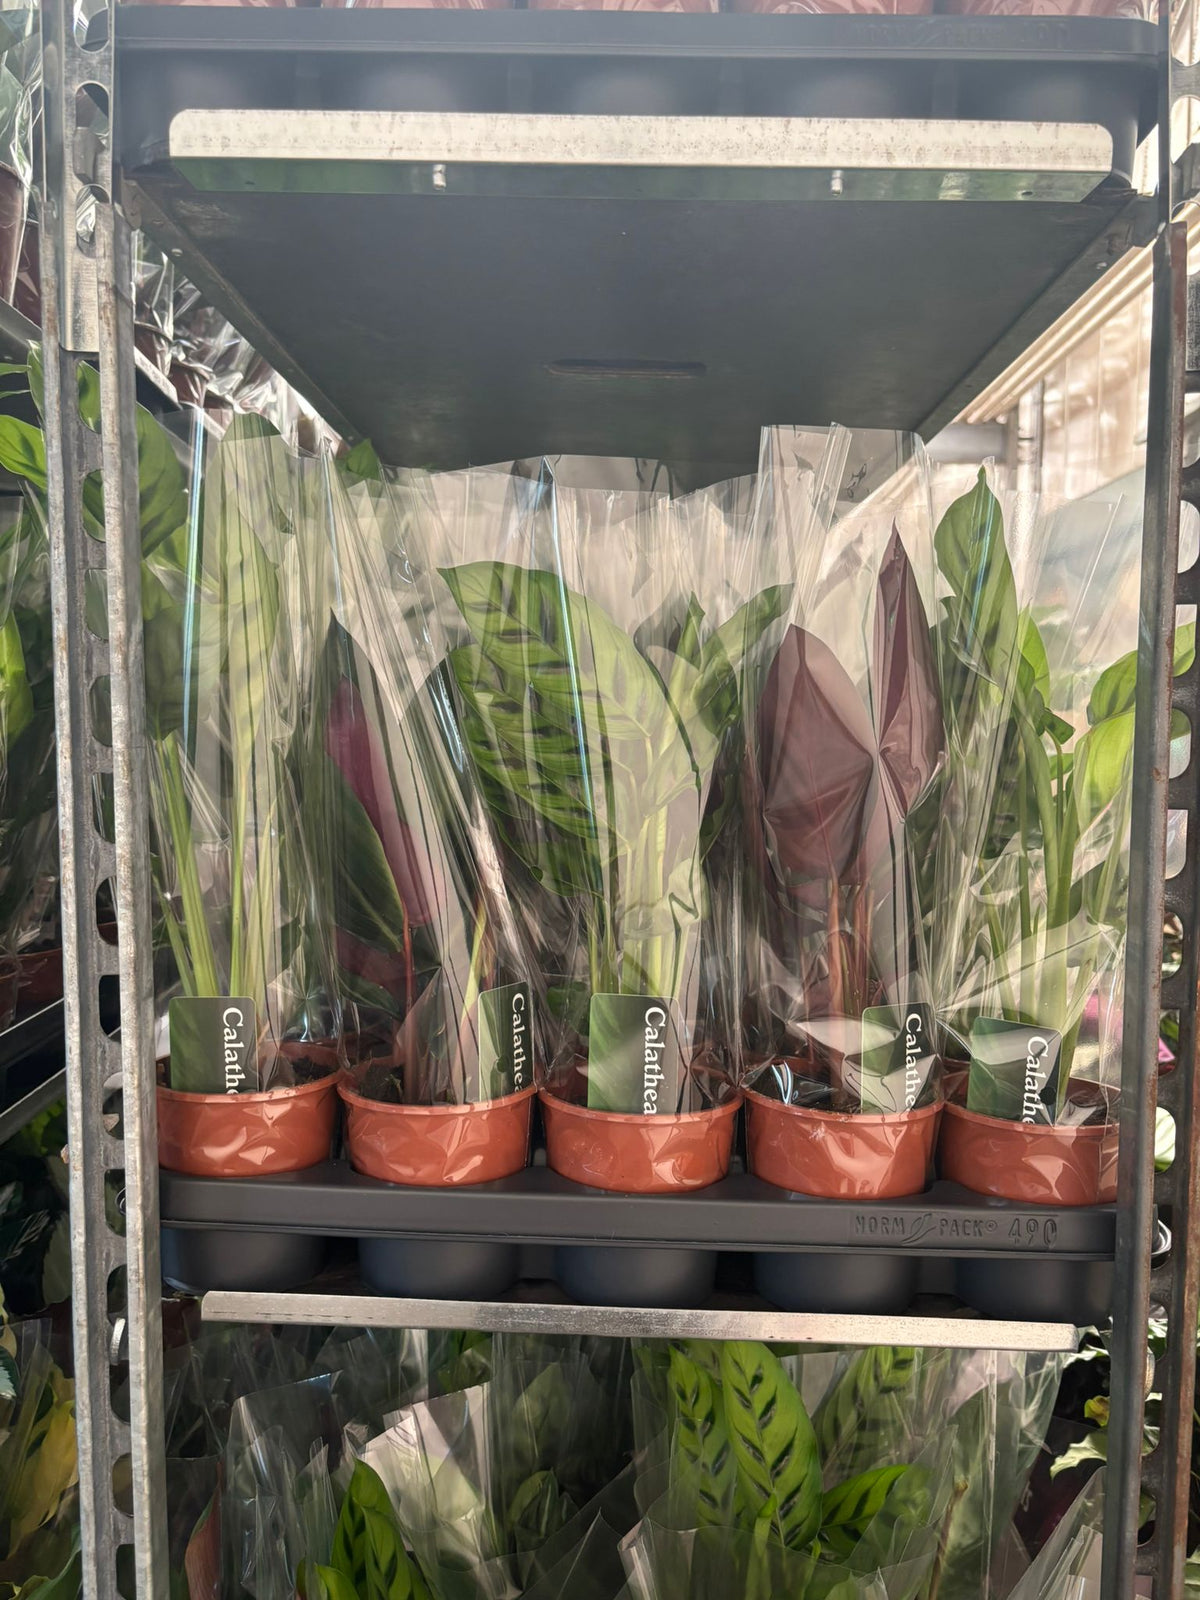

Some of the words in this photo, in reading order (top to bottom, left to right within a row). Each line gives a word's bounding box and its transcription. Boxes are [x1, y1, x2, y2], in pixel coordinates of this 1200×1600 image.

[643, 1007, 666, 1115] Calathea
[905, 1013, 922, 1112] Calathe
[1008, 1217, 1058, 1248] 490
